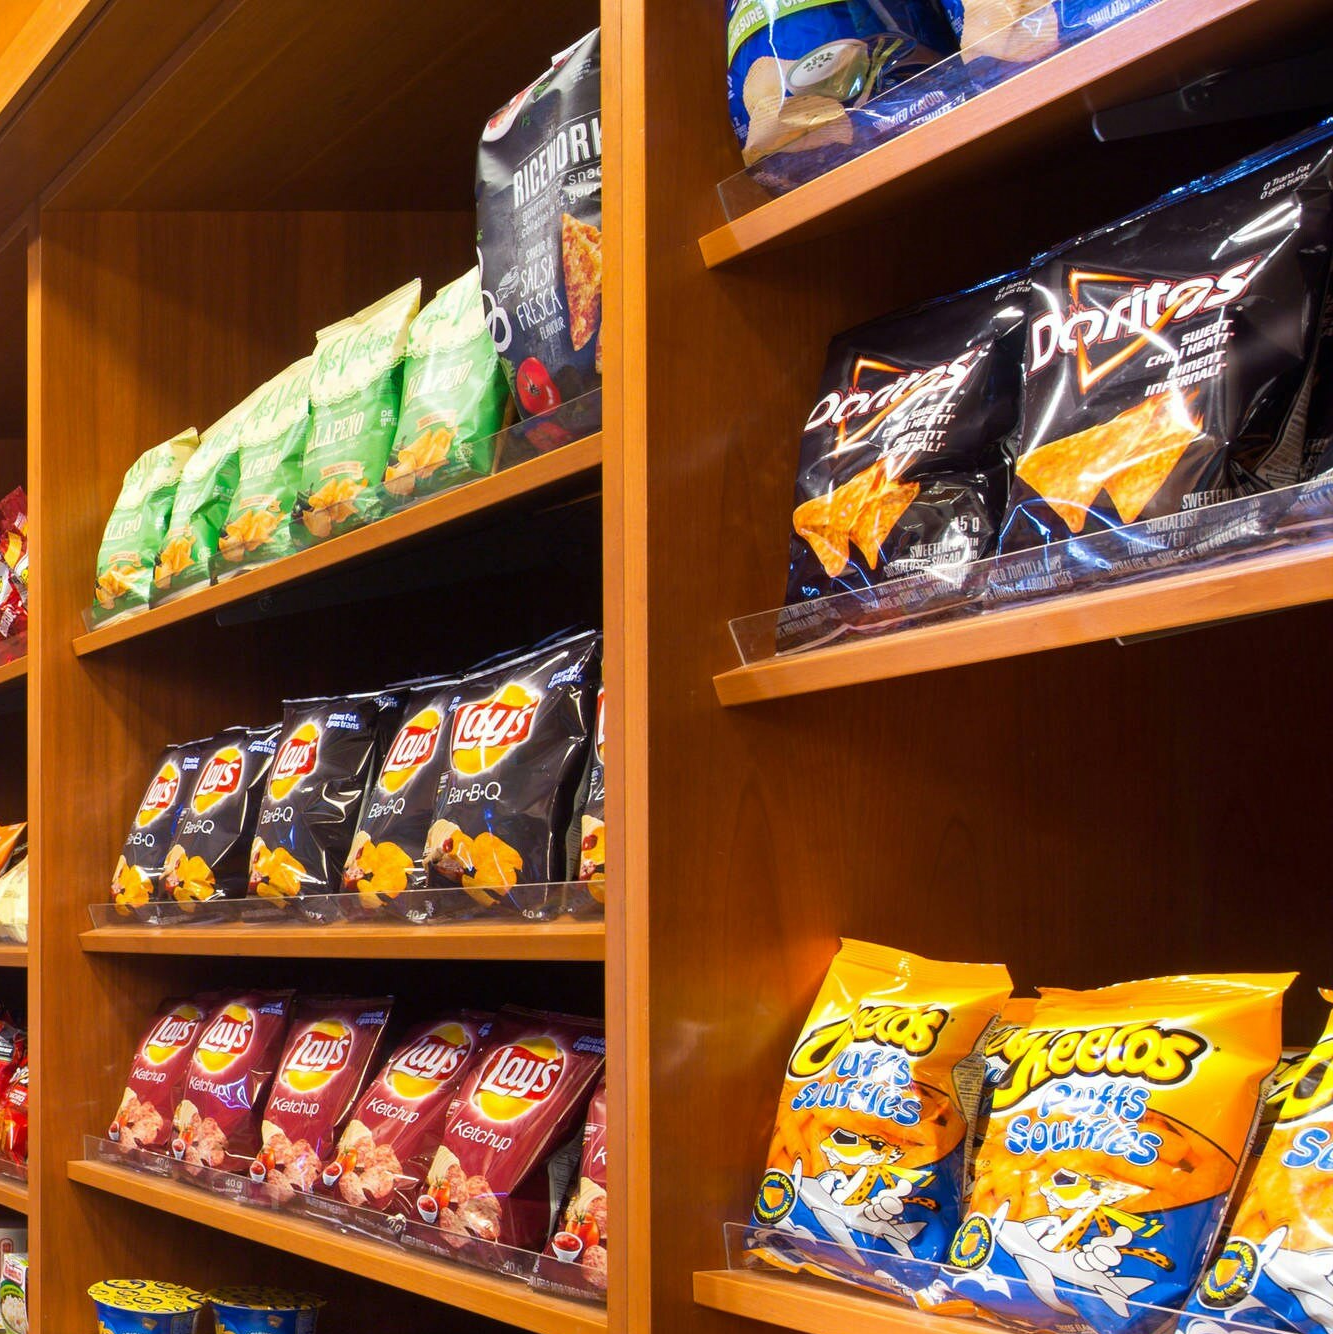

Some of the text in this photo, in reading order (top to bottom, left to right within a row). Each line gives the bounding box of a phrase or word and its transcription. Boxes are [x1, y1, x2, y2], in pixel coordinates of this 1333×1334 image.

[520, 255, 554, 298] SALSA
[516, 286, 562, 331] FRESCA
[1028, 256, 1261, 376] Doritos
[540, 316, 565, 341] FLAVOUR
[1181, 320, 1233, 344] SWEET
[1167, 351, 1225, 380] PIMENT
[803, 350, 981, 432] Doritos
[385, 728, 437, 772] Lay's
[200, 1014, 252, 1054] Lay's
[286, 1035, 350, 1072] Lay's
[397, 1042, 467, 1078] Lay's
[133, 1067, 166, 1084] Ketchup
[481, 1050, 562, 1095] Lay's
[271, 1097, 320, 1116] Ketchup
[367, 1098, 419, 1123] Ketchup
[451, 1120, 512, 1152] Ketchup
